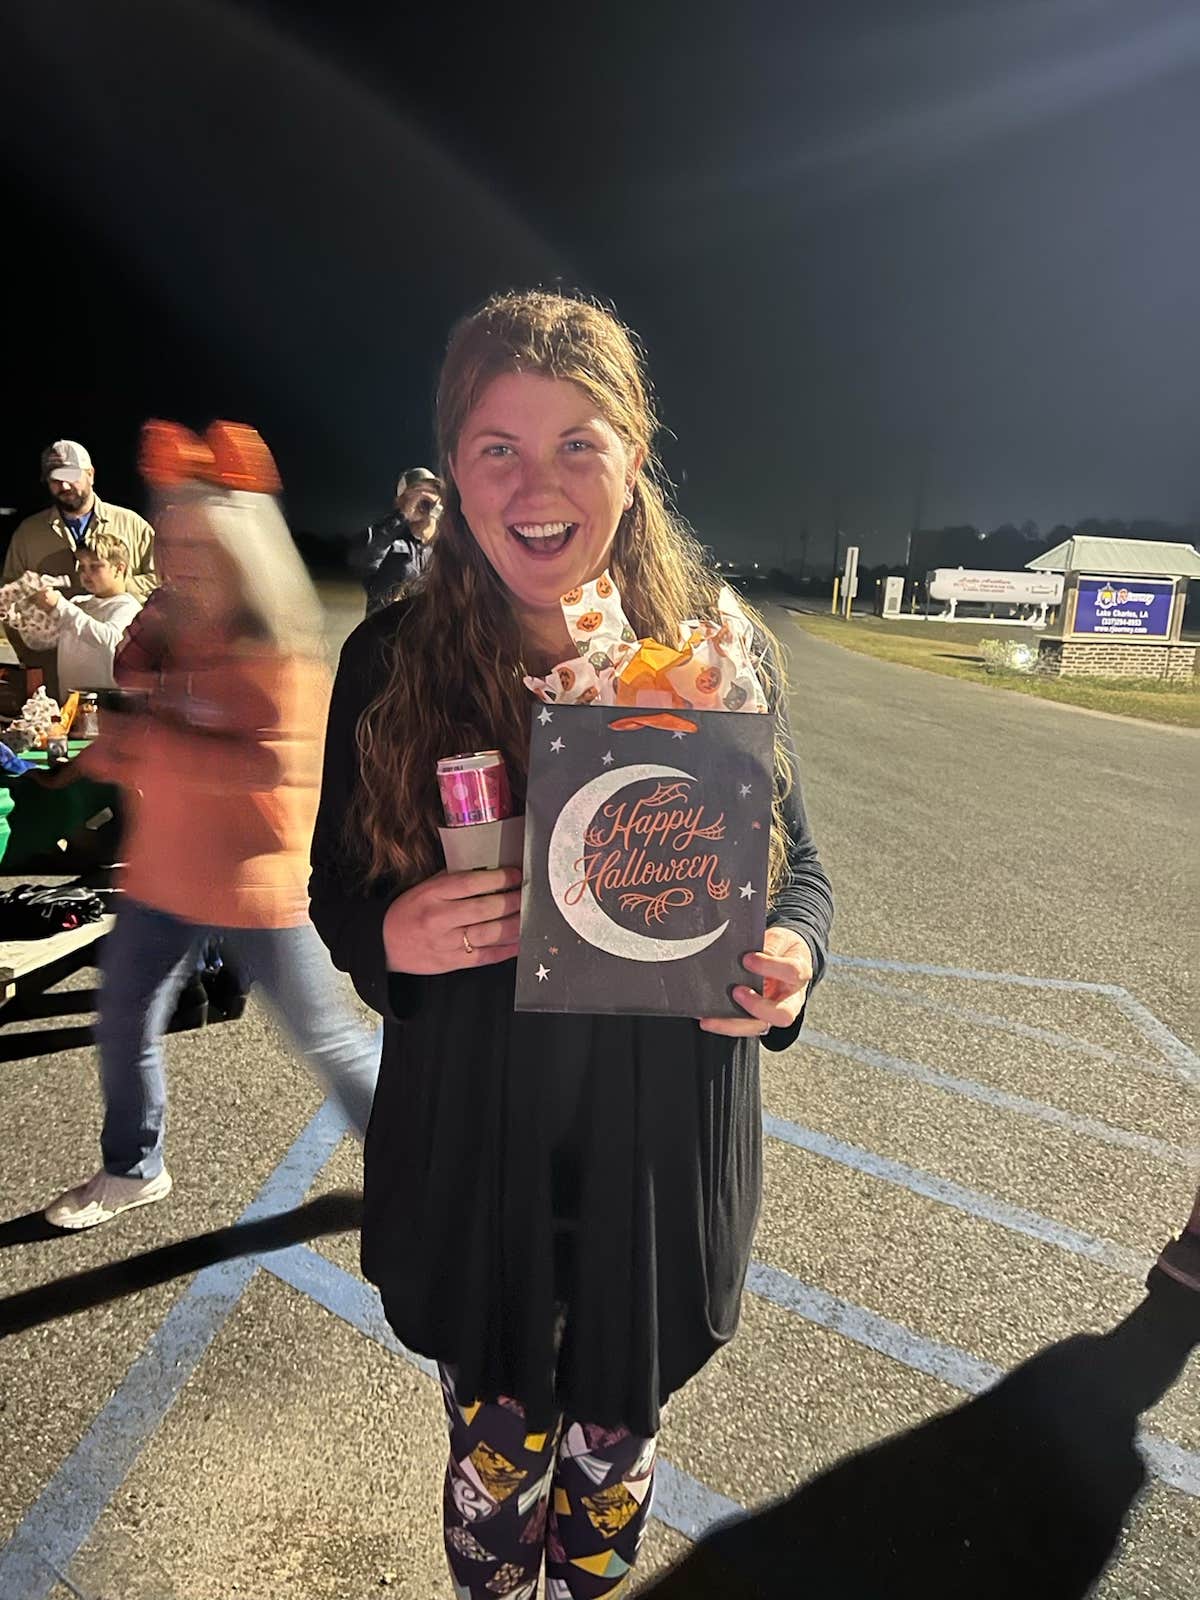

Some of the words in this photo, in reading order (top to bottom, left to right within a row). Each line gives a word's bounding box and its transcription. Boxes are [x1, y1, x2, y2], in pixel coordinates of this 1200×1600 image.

[1096, 609, 1111, 617] Lake
[599, 801, 707, 851] Happy
[564, 848, 725, 906] Halloween
